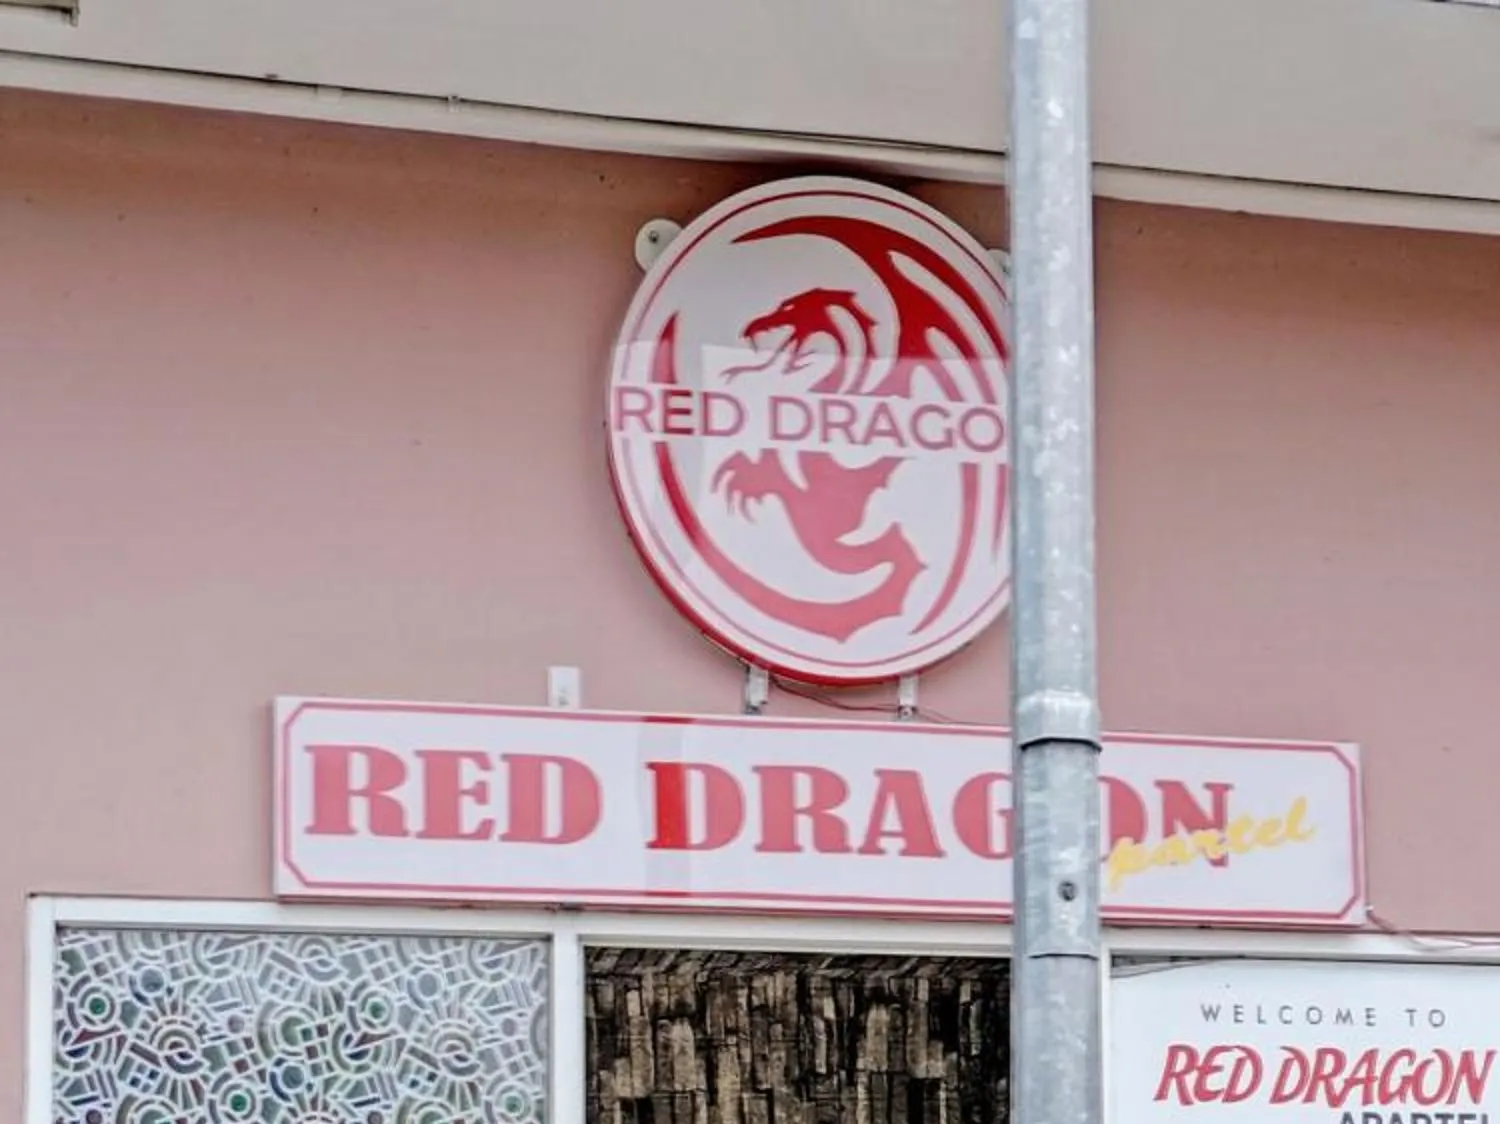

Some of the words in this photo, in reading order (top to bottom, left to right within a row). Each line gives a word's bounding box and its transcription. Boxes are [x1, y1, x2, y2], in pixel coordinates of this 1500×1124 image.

[613, 386, 744, 437] RED
[769, 396, 1005, 453] DRAGO
[303, 744, 603, 845] RED
[1105, 796, 1316, 893] partel
[1202, 1004, 1377, 1027] WELCOME
[1405, 1009, 1446, 1028] TO
[1153, 1043, 1263, 1106] RED
[1269, 1045, 1497, 1109] DRAGON
